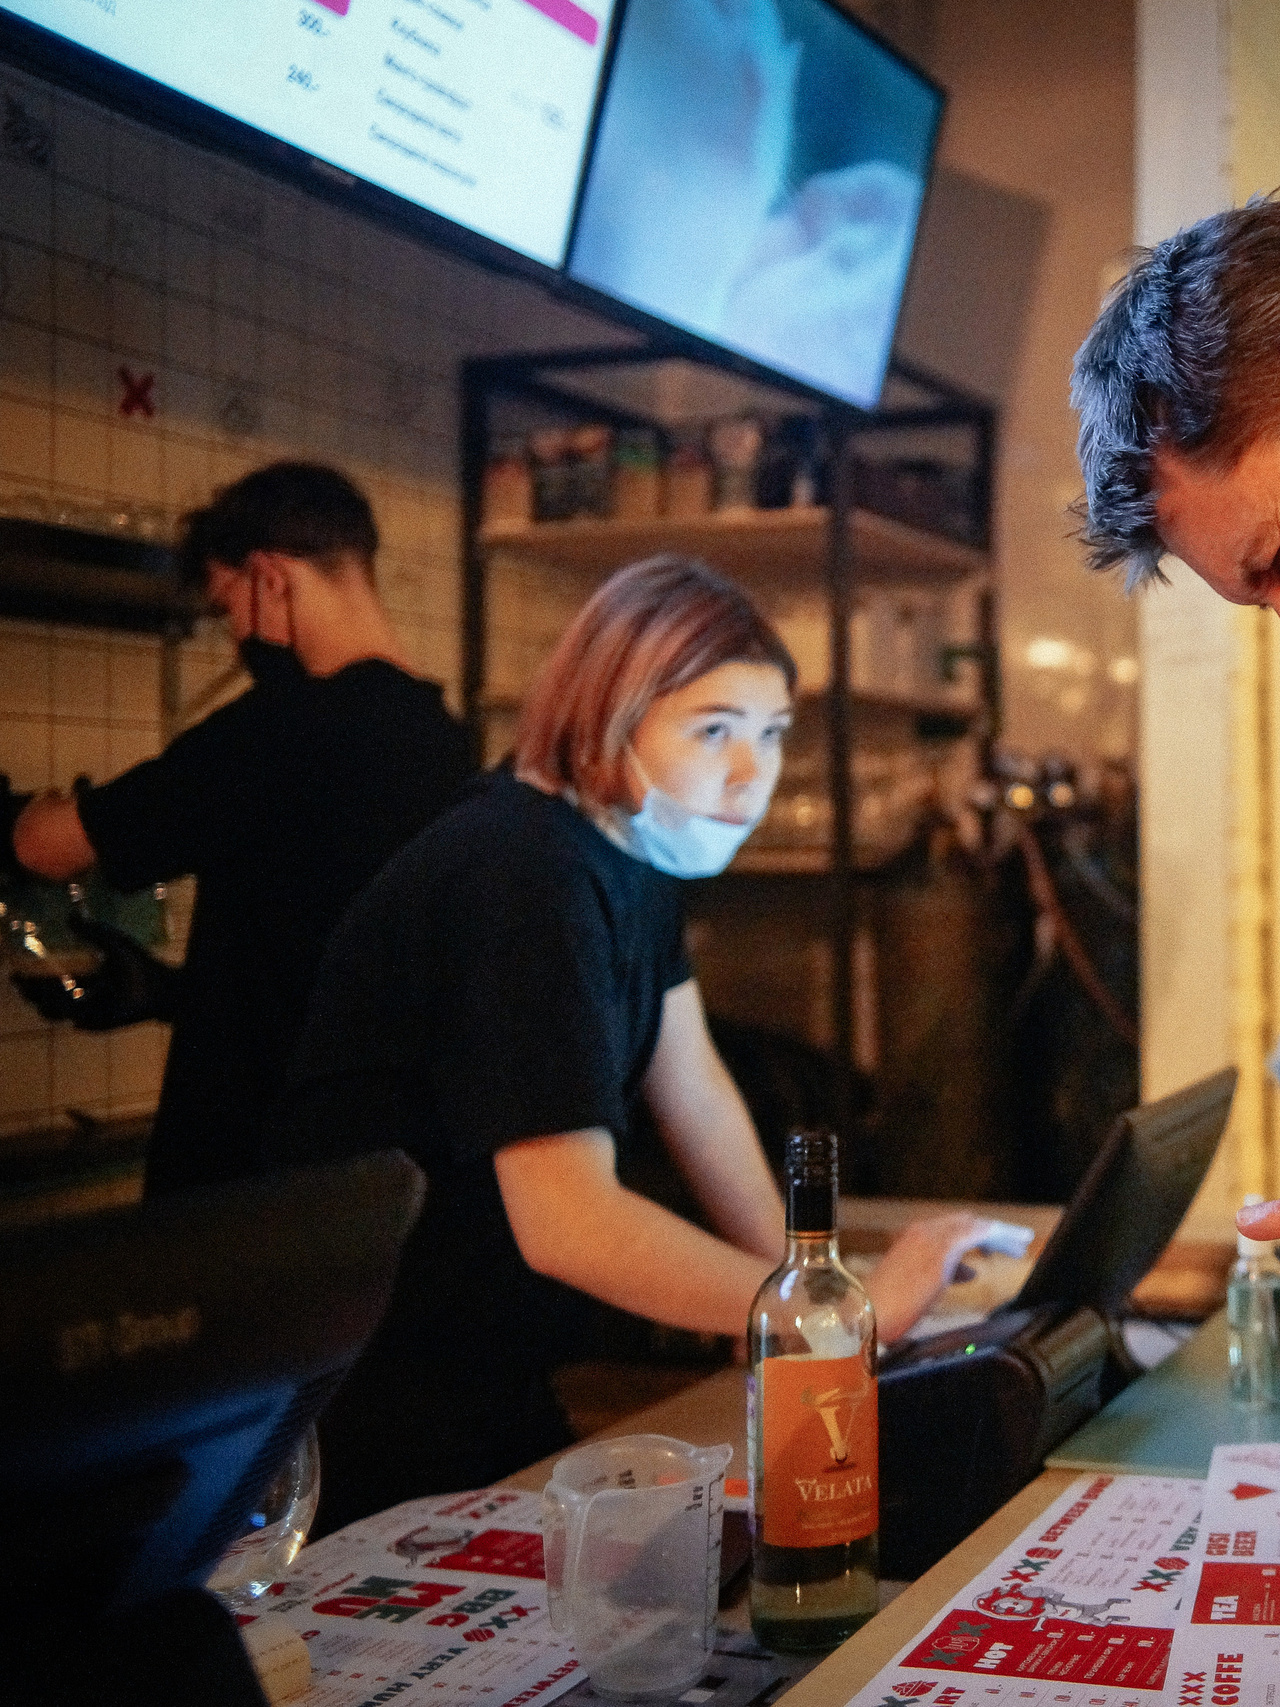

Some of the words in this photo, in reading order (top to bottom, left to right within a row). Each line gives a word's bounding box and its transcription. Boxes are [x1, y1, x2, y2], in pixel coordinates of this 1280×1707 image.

[1168, 1526, 1199, 1552] VERY
[1231, 1531, 1256, 1556] BEER
[1210, 1596, 1240, 1622] TEA
[409, 1646, 469, 1680] VERY
[973, 1642, 1016, 1670] HOT
[1210, 1652, 1244, 1706] COFFE
[932, 1686, 966, 1707] RT
